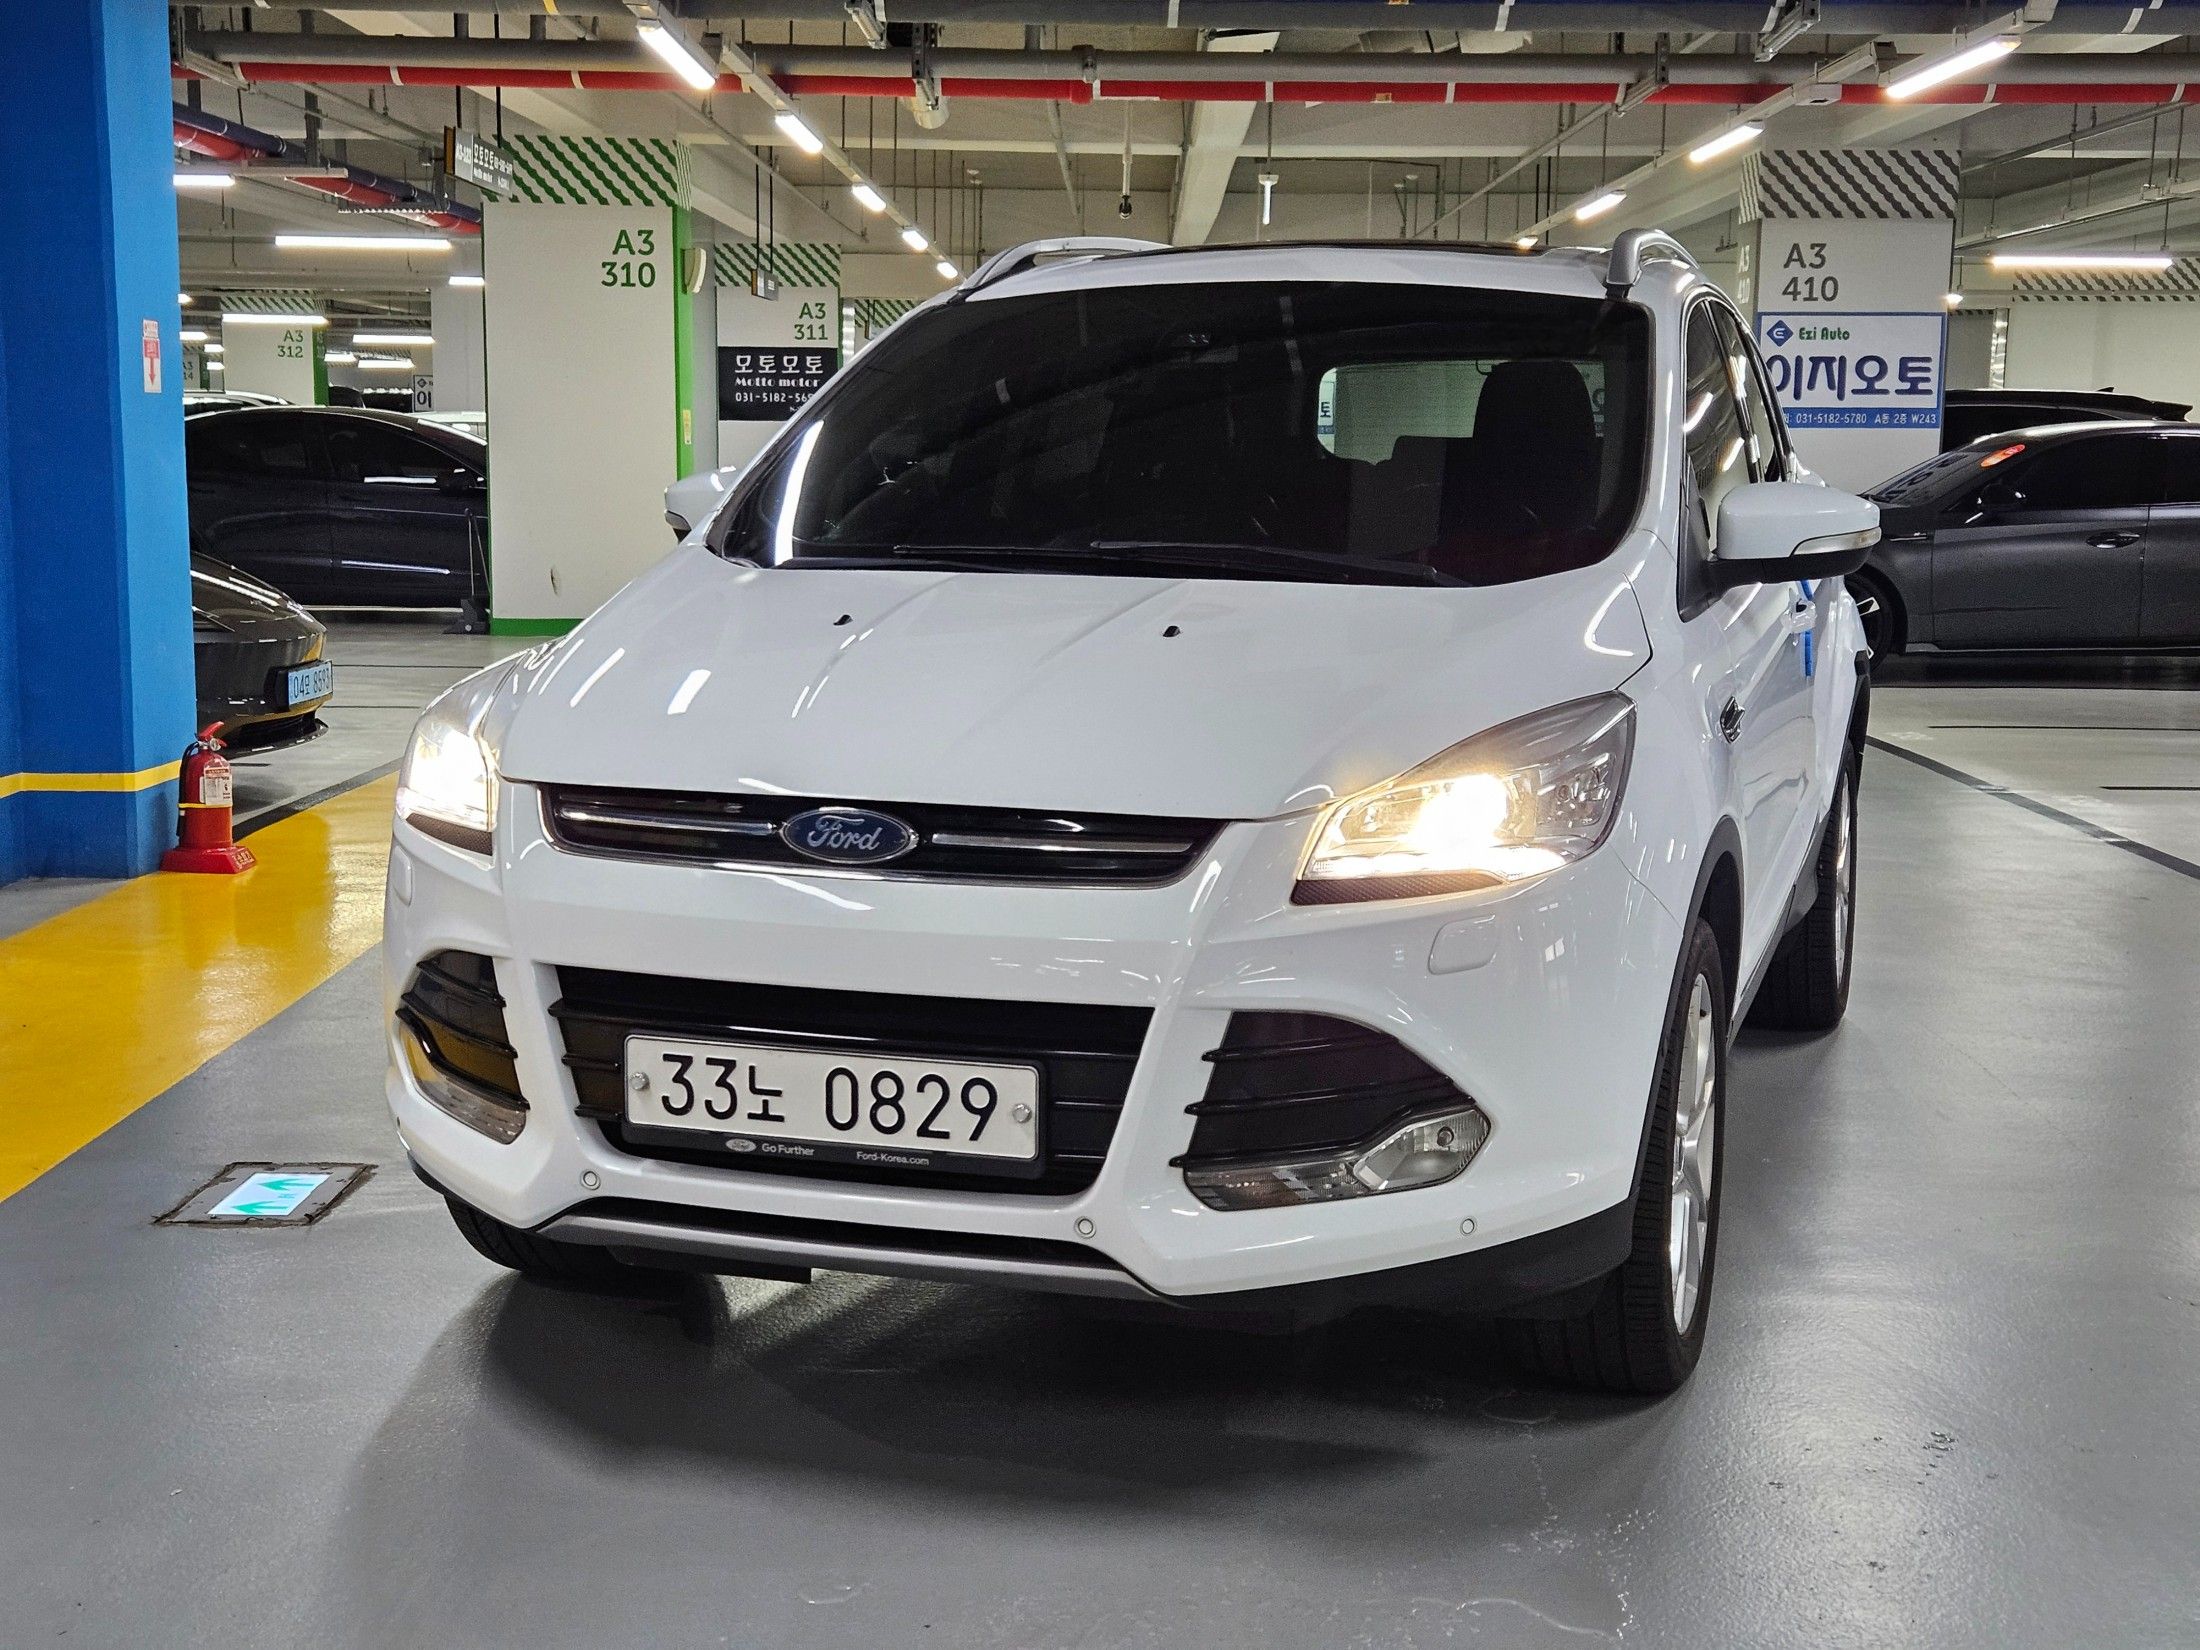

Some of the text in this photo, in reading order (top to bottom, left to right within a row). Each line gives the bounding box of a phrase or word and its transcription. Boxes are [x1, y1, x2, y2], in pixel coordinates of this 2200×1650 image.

[612, 229, 655, 256] A3
[1783, 242, 1828, 269] A3
[600, 261, 656, 288] 310
[1781, 275, 1839, 302] 410
[799, 302, 827, 320] A3
[283, 329, 304, 342] A3
[794, 324, 828, 340] 311
[1798, 326, 1850, 341] Ezi Auto
[277, 345, 304, 358] 312
[734, 354, 824, 374] 모토모토
[735, 377, 820, 388] Motto motor
[1766, 354, 1934, 401] 이지오토
[1795, 413, 1867, 424] 031-5182-5780
[1911, 413, 1937, 424] W243
[806, 814, 883, 851] Ford
[660, 1051, 998, 1141] 33노 0829
[761, 1142, 777, 1153] Go
[778, 1144, 815, 1156] Further
[856, 1151, 930, 1166] Ford-Korea.com
